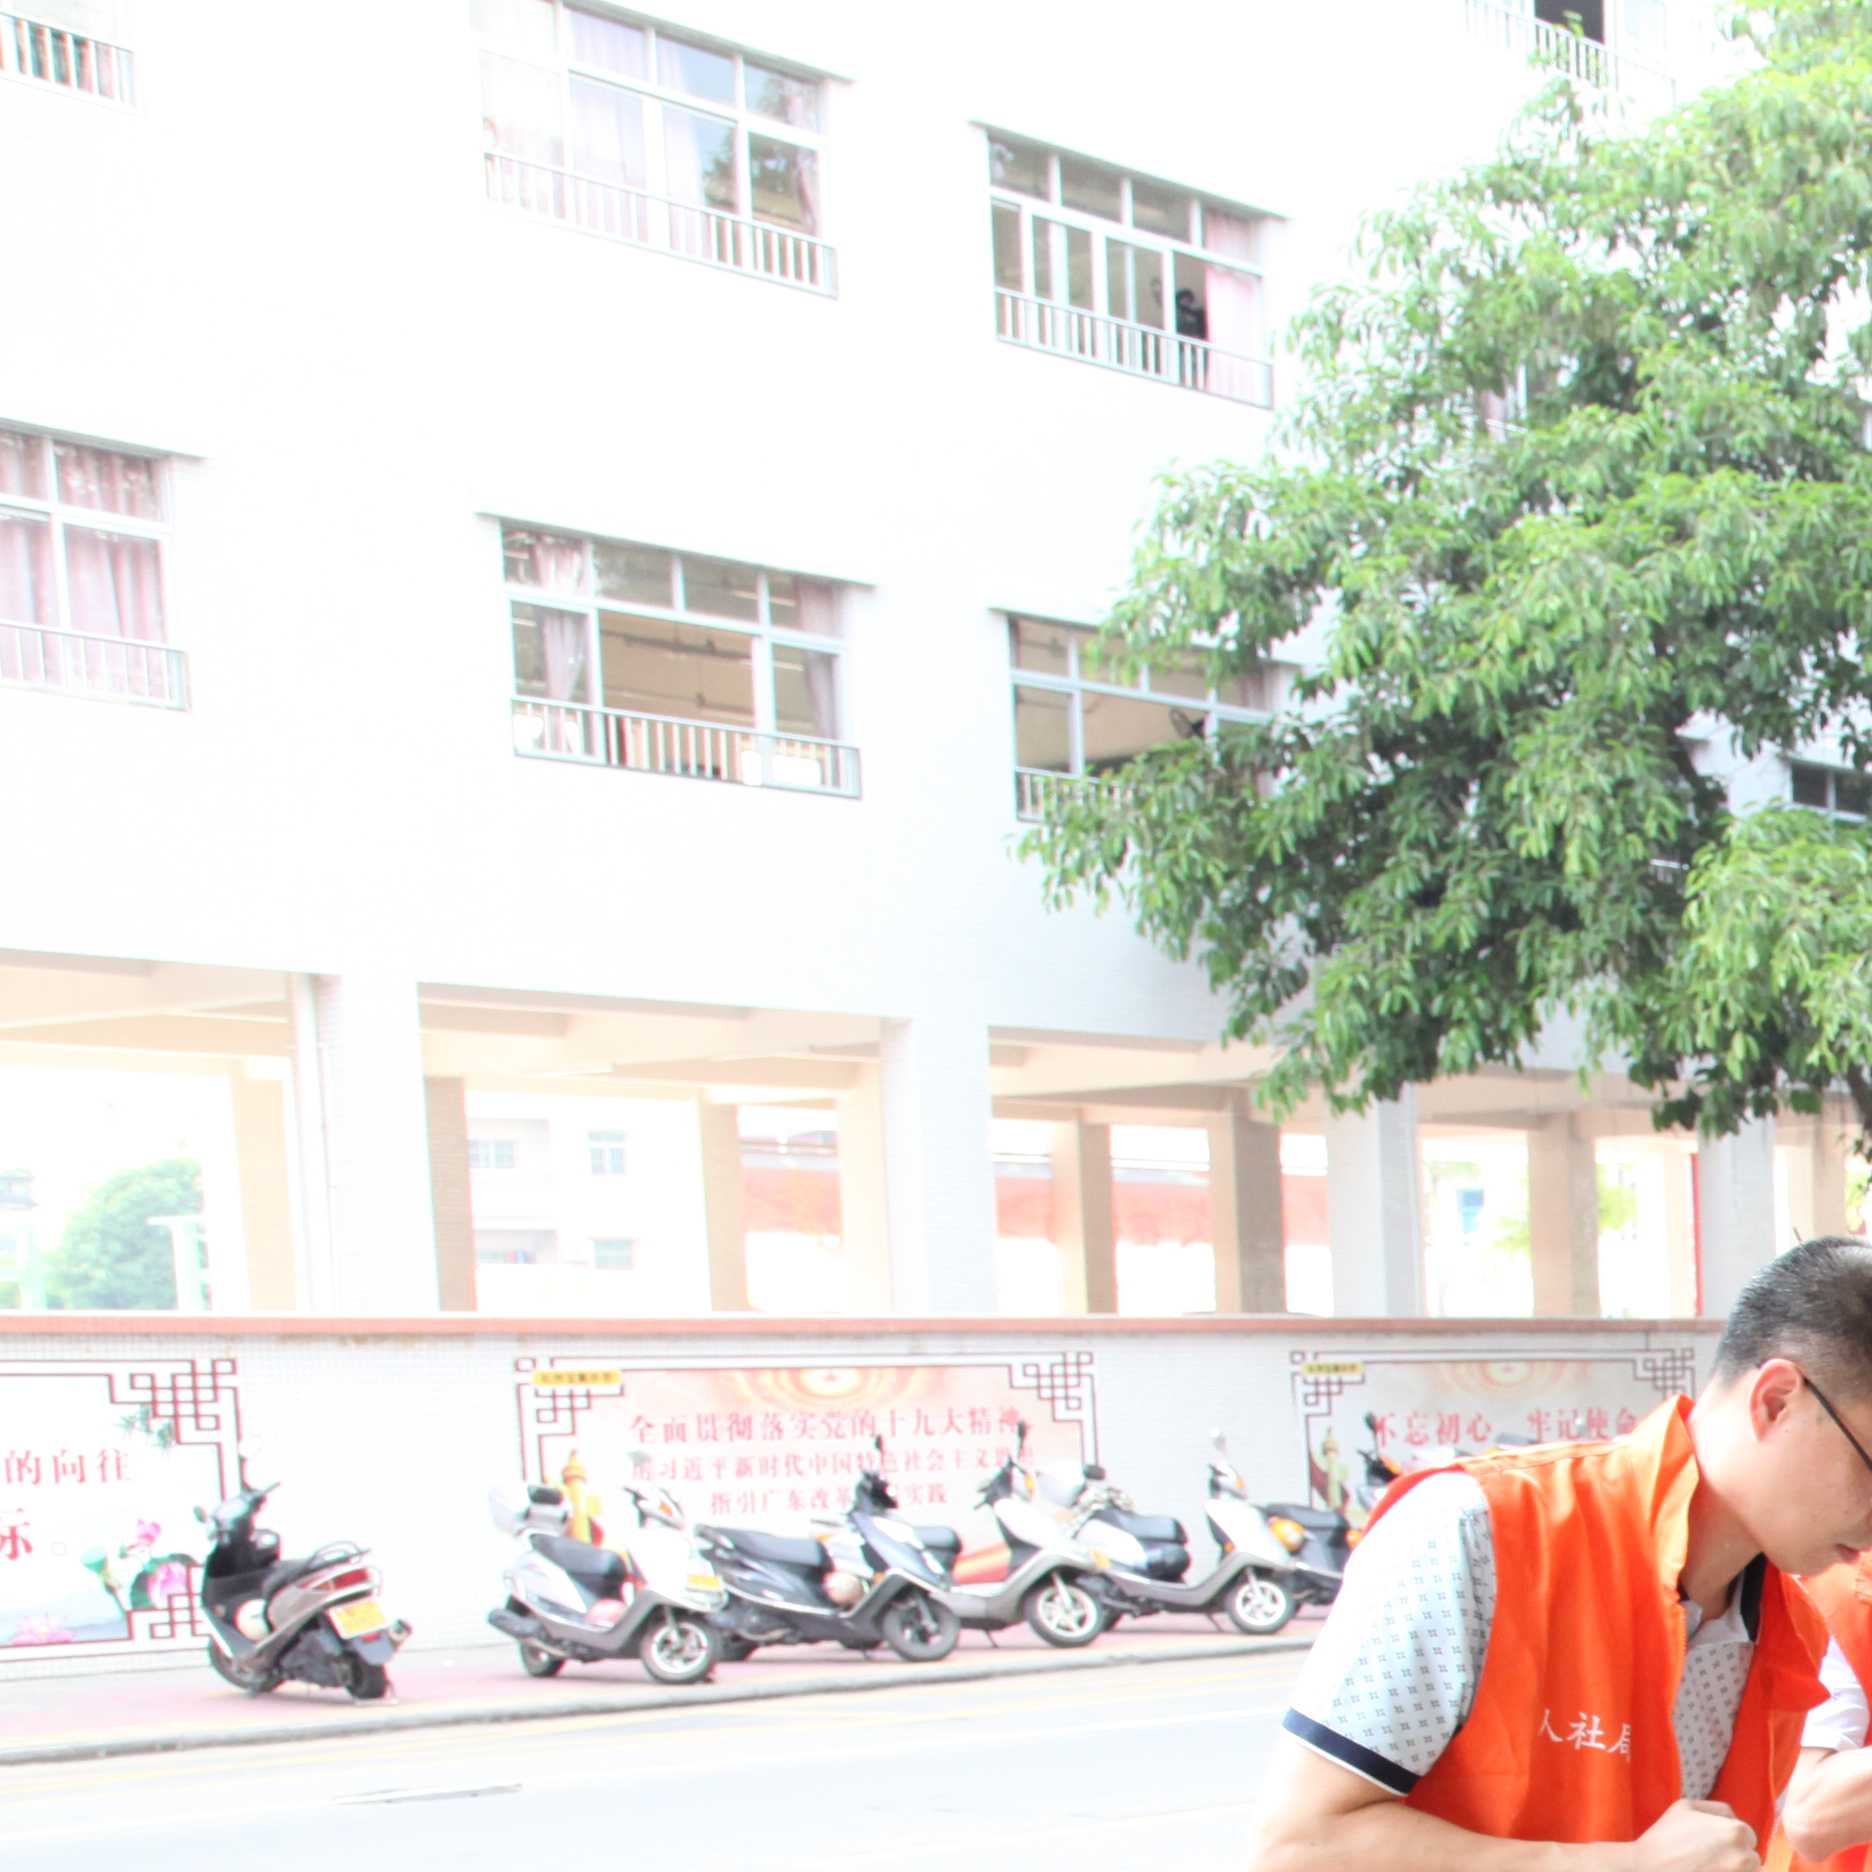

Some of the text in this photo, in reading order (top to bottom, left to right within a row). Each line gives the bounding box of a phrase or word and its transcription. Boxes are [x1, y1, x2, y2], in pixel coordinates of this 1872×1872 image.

[1372, 1406, 1638, 1447] 不忘初心 牢记使命
[3, 1447, 131, 1486] 的向往
[710, 1482, 948, 1516] 指引广东改革实践
